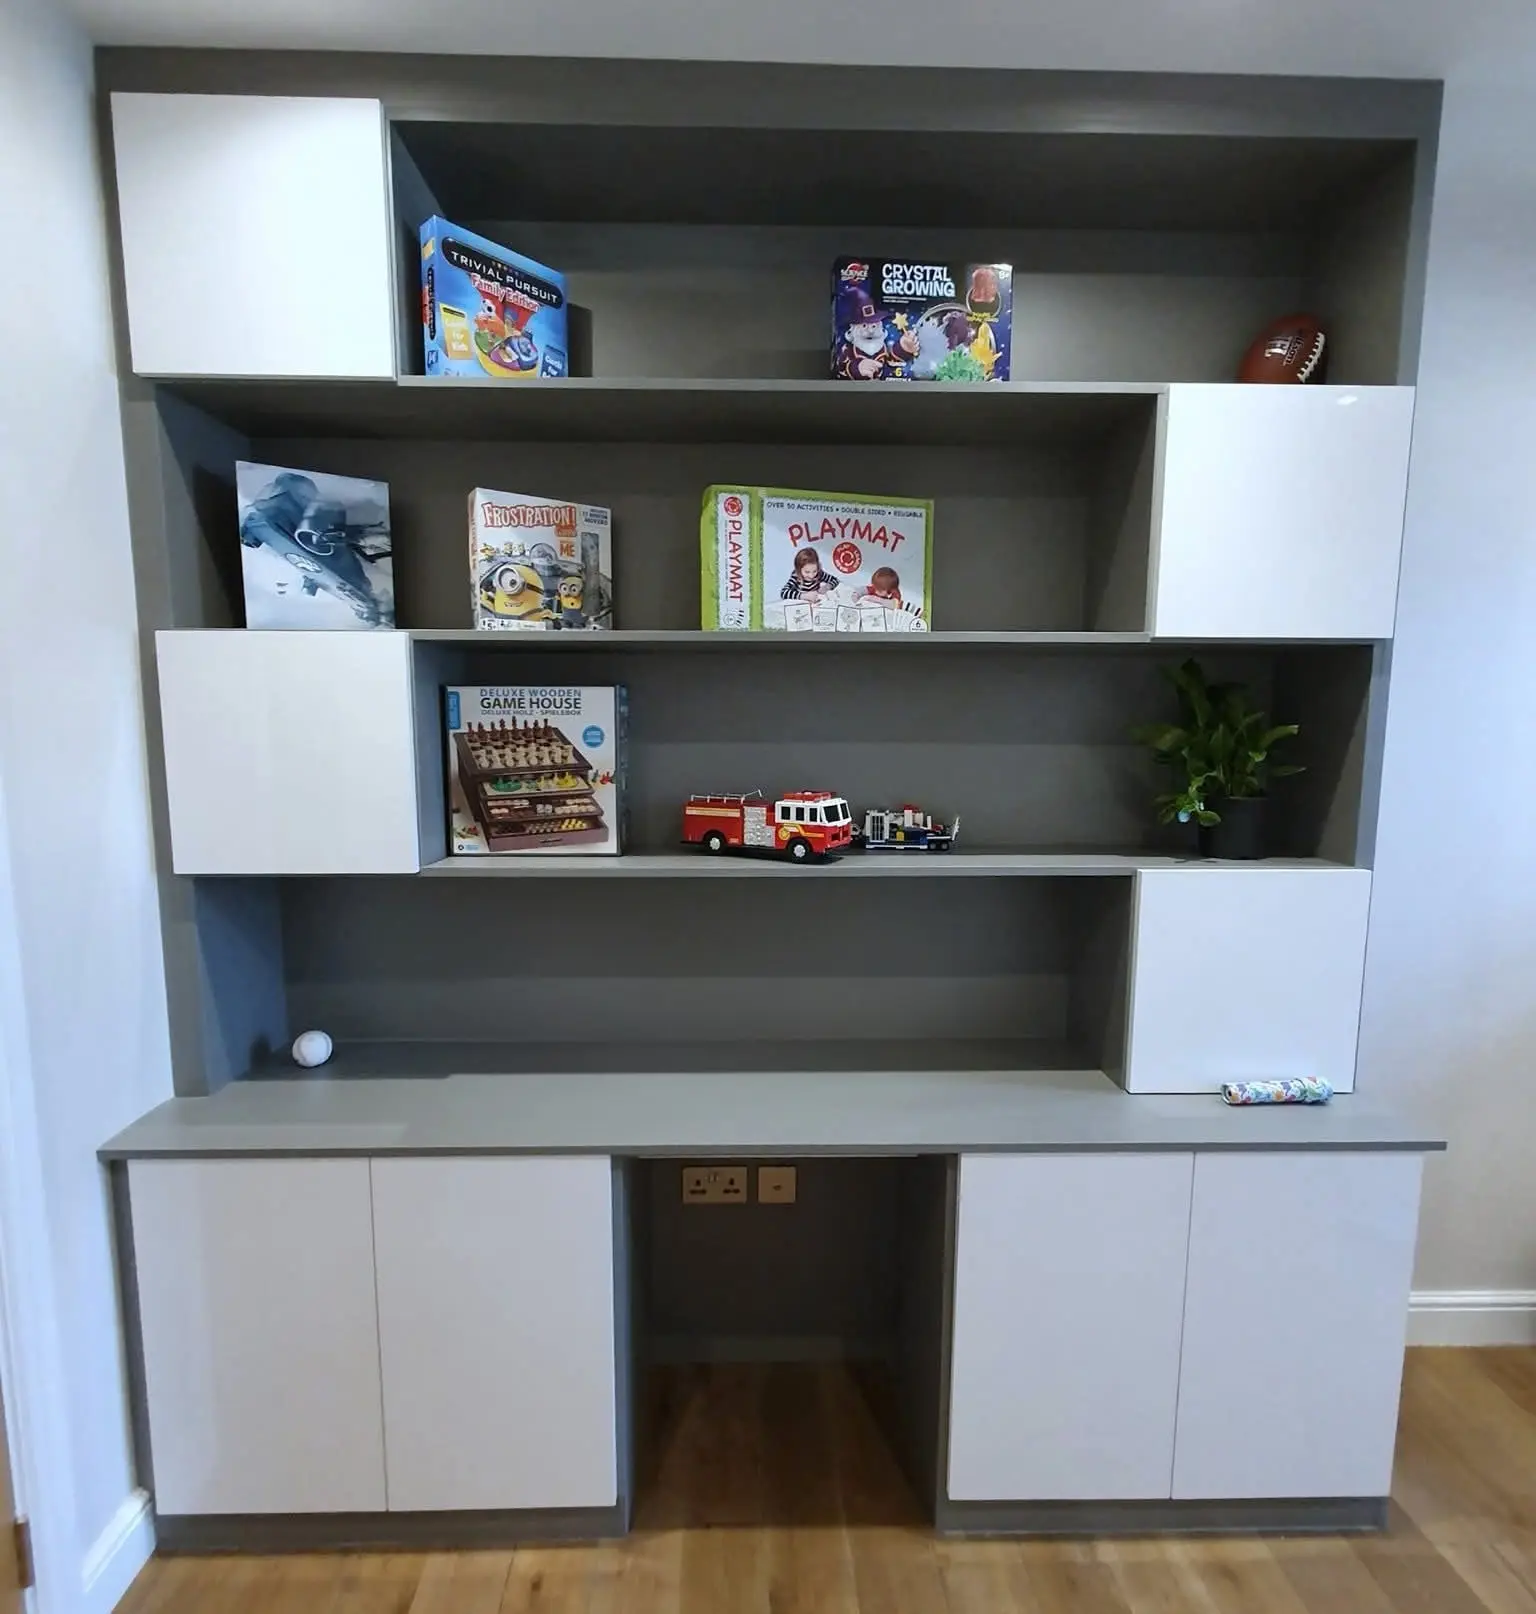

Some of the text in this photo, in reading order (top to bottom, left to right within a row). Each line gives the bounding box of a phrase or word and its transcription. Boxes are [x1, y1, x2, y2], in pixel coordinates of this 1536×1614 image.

[451, 251, 558, 303] TRIVIAL PURSUIT
[882, 263, 951, 281] CRYSTAL
[882, 279, 955, 297] GROWING
[895, 367, 902, 377] 6
[482, 502, 576, 528] FRUSTRATION!
[796, 504, 834, 512] ACTIVITIES
[788, 518, 905, 552] PLAYMAT
[559, 543, 576, 557] ME
[728, 519, 744, 603] PLAYMAT
[480, 688, 582, 697] DELUXE WOODEN
[480, 697, 582, 709] GAME HOUSE
